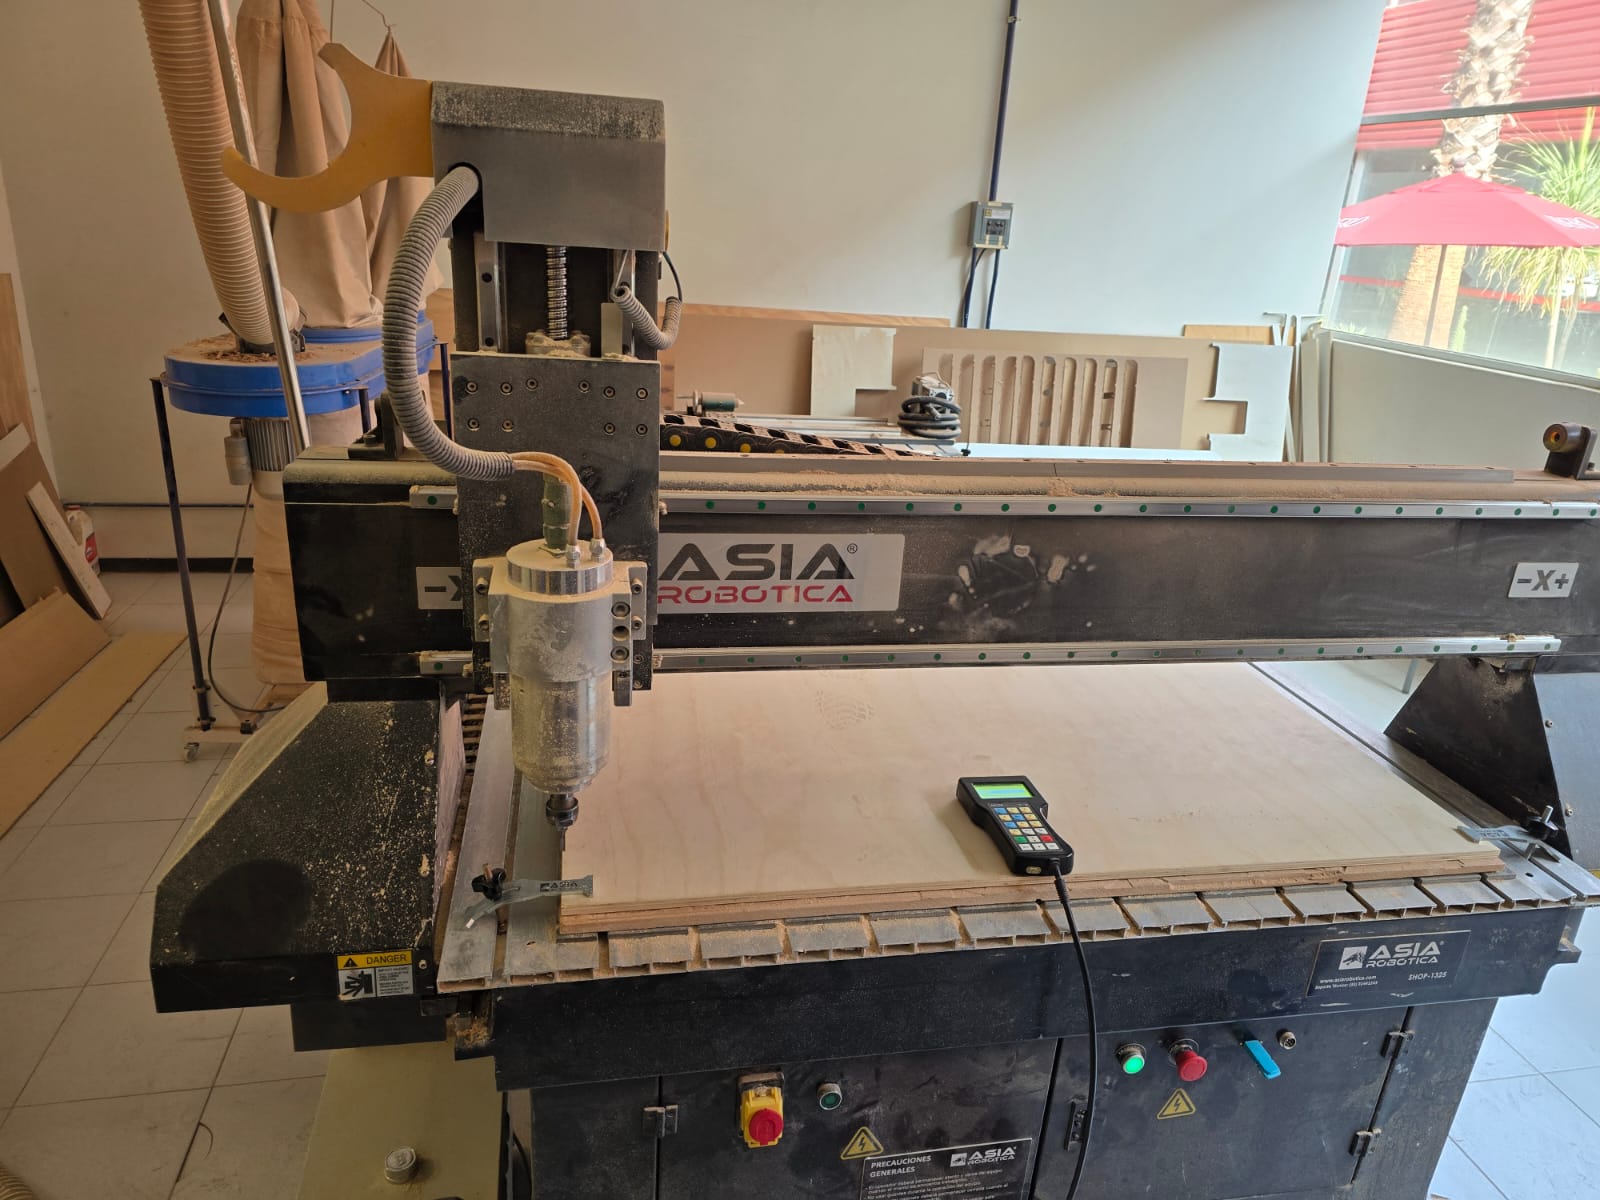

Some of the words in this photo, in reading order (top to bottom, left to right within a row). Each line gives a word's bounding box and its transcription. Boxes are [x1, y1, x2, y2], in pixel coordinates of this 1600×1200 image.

[657, 584, 854, 604] ROBOTICA
[366, 954, 407, 965] DANGER
[1366, 955, 1439, 968] ROBOTICA
[1408, 971, 1448, 981] SHOP-1325
[871, 1155, 932, 1169] PRECAUCIONES
[967, 1154, 1015, 1165] ROBOTICA
[870, 1166, 915, 1178] GENERALES
